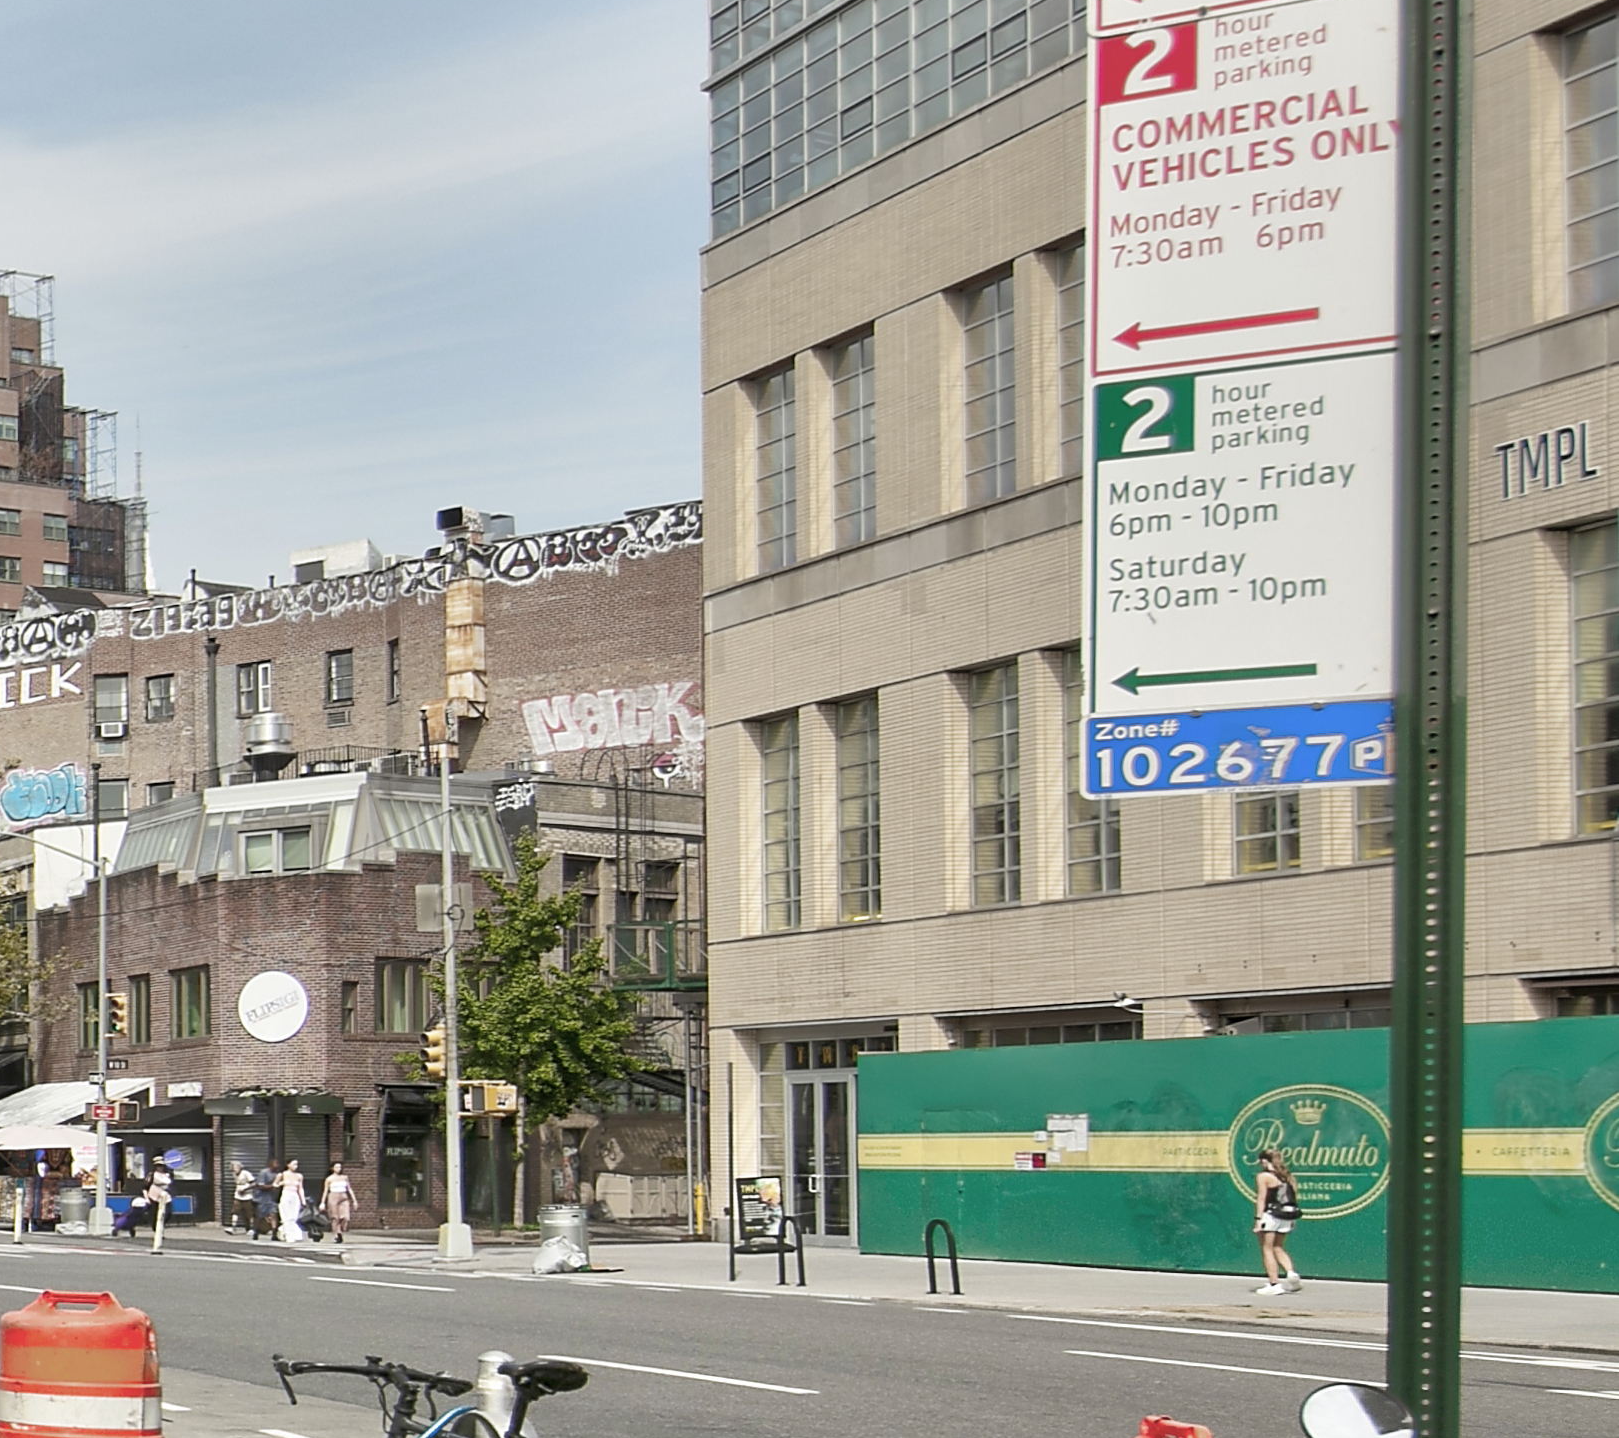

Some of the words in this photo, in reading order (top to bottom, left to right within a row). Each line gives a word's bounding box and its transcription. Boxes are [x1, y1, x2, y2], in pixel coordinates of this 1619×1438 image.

[1214, 13, 1274, 39] hour
[1214, 24, 1328, 62] metered
[1123, 28, 1176, 96] 2
[1213, 55, 1313, 91] parking
[1112, 85, 1369, 153] COMMERCIAL
[1112, 137, 1296, 191] VEHICLES
[1110, 204, 1220, 238] Monday
[1251, 186, 1342, 217] Friday
[1111, 235, 1223, 269] 7:30am
[1256, 221, 1324, 250] 6pm
[1212, 382, 1272, 404] hour
[1212, 395, 1324, 427] metered
[1120, 385, 1173, 454] 2
[1212, 423, 1310, 454] parking
[1494, 421, 1599, 500] TMPL
[1109, 475, 1226, 506] Monday
[1260, 462, 1355, 490] Friday
[1109, 513, 1172, 539] 6pm
[1201, 503, 1279, 530] 10pm
[1109, 551, 1246, 581] Saturday
[1109, 586, 1218, 613] 7:30am
[1249, 577, 1327, 604] 10pm
[1095, 719, 1179, 741] Zone#
[1096, 734, 1346, 789] 102677
[1297, 1181, 1352, 1191] ASTICCERIA
[1297, 1193, 1330, 1201] ALIANA
